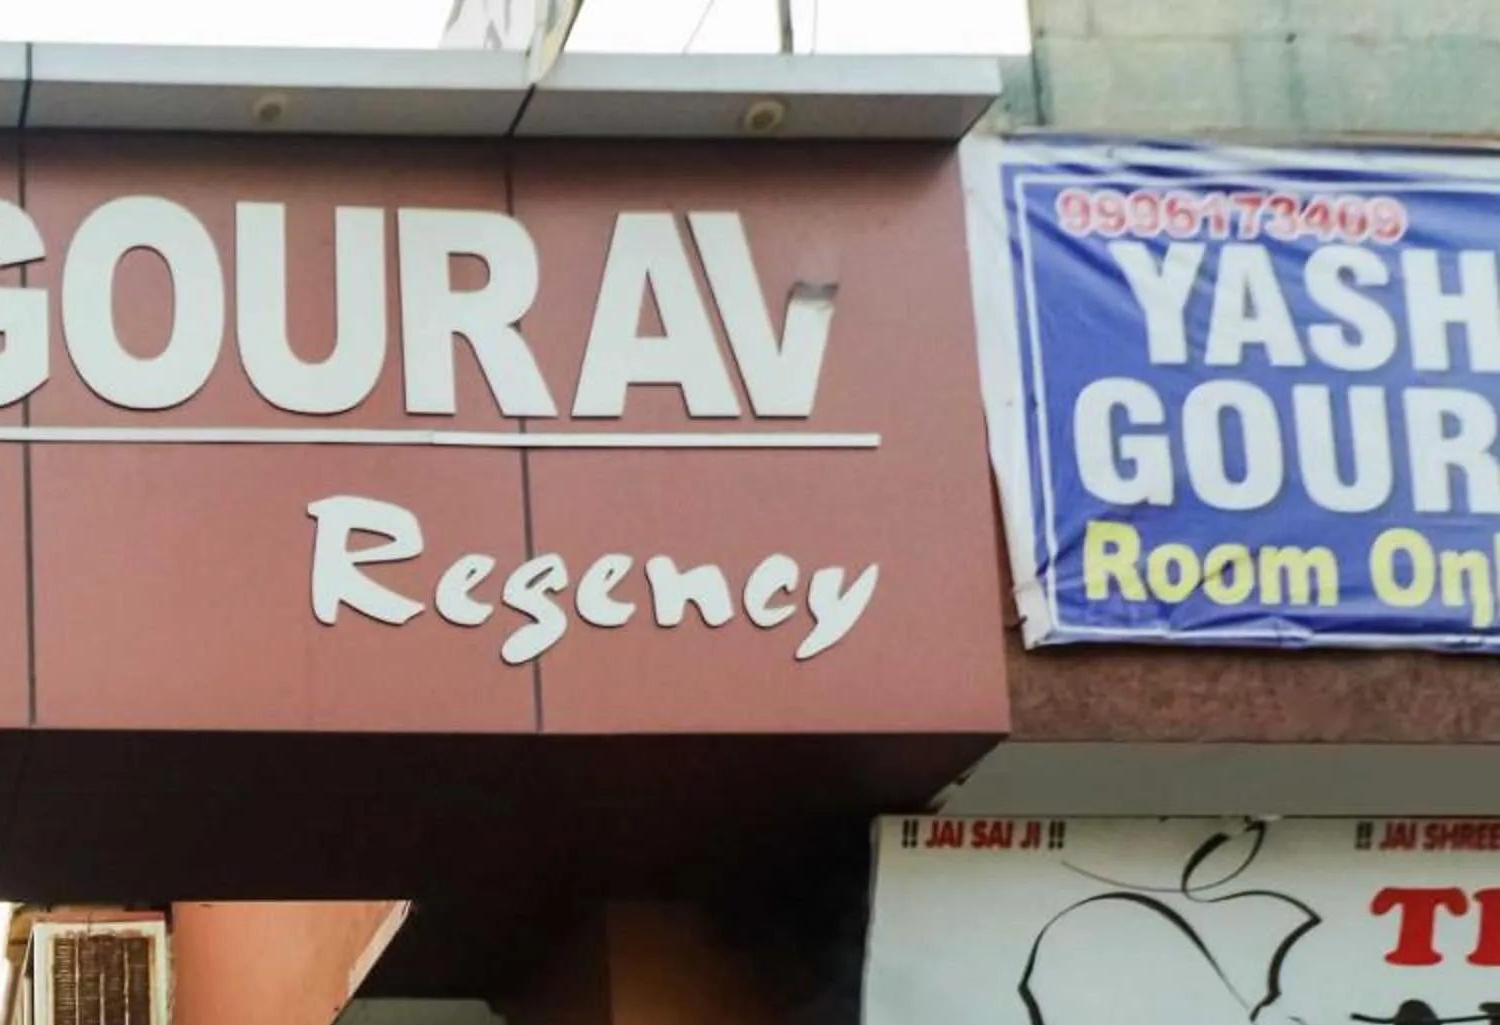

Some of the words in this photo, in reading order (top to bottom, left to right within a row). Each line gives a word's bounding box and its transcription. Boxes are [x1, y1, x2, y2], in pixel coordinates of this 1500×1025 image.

[1108, 240, 1500, 373] YASH
[1073, 377, 1500, 514] GOUR
[308, 495, 879, 664] Regency
[1083, 520, 1339, 606] Room
[925, 819, 965, 848] JAI
[971, 820, 1014, 848] SAI
[1020, 821, 1041, 849] JI
[1380, 821, 1418, 850] JAI
